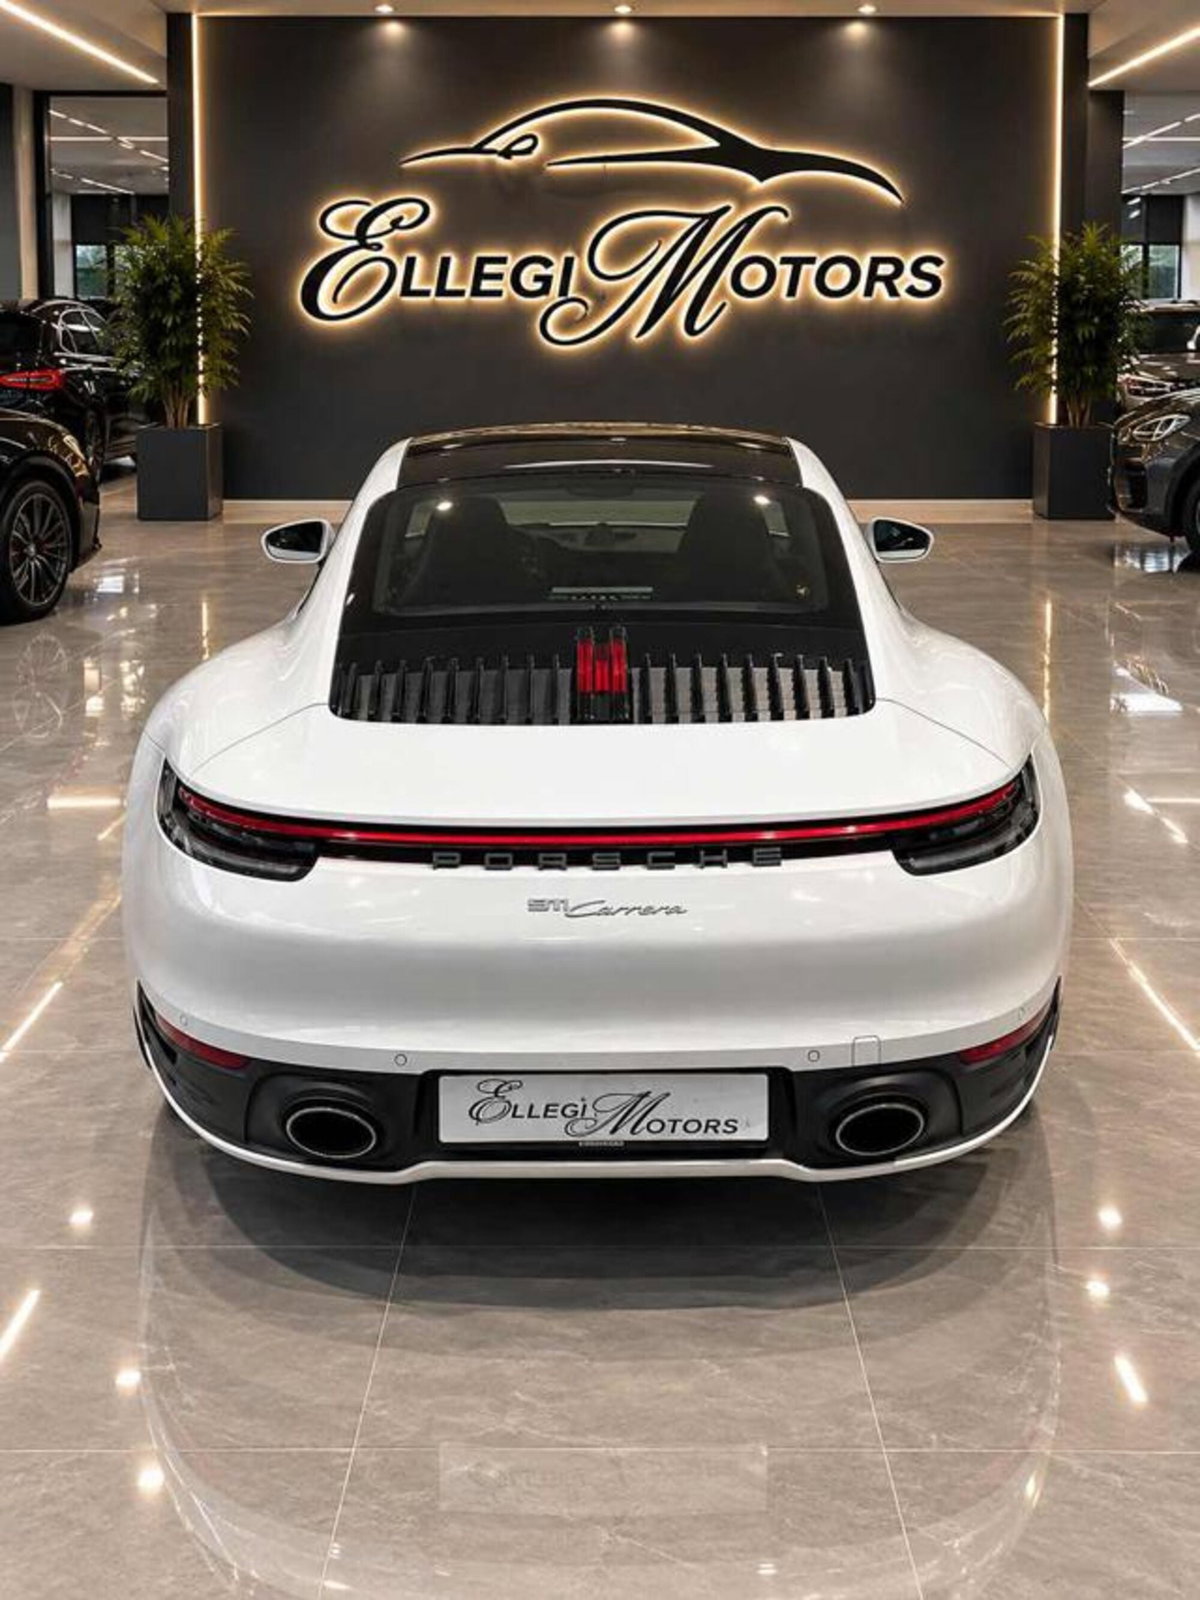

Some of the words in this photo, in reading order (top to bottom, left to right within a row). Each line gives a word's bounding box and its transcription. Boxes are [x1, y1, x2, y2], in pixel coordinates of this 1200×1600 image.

[301, 198, 573, 321] ELLEGI
[538, 205, 943, 346] MOTORS
[432, 848, 782, 870] PORSCHE
[565, 900, 687, 917] Carrera
[564, 1091, 739, 1137] MOTORS
